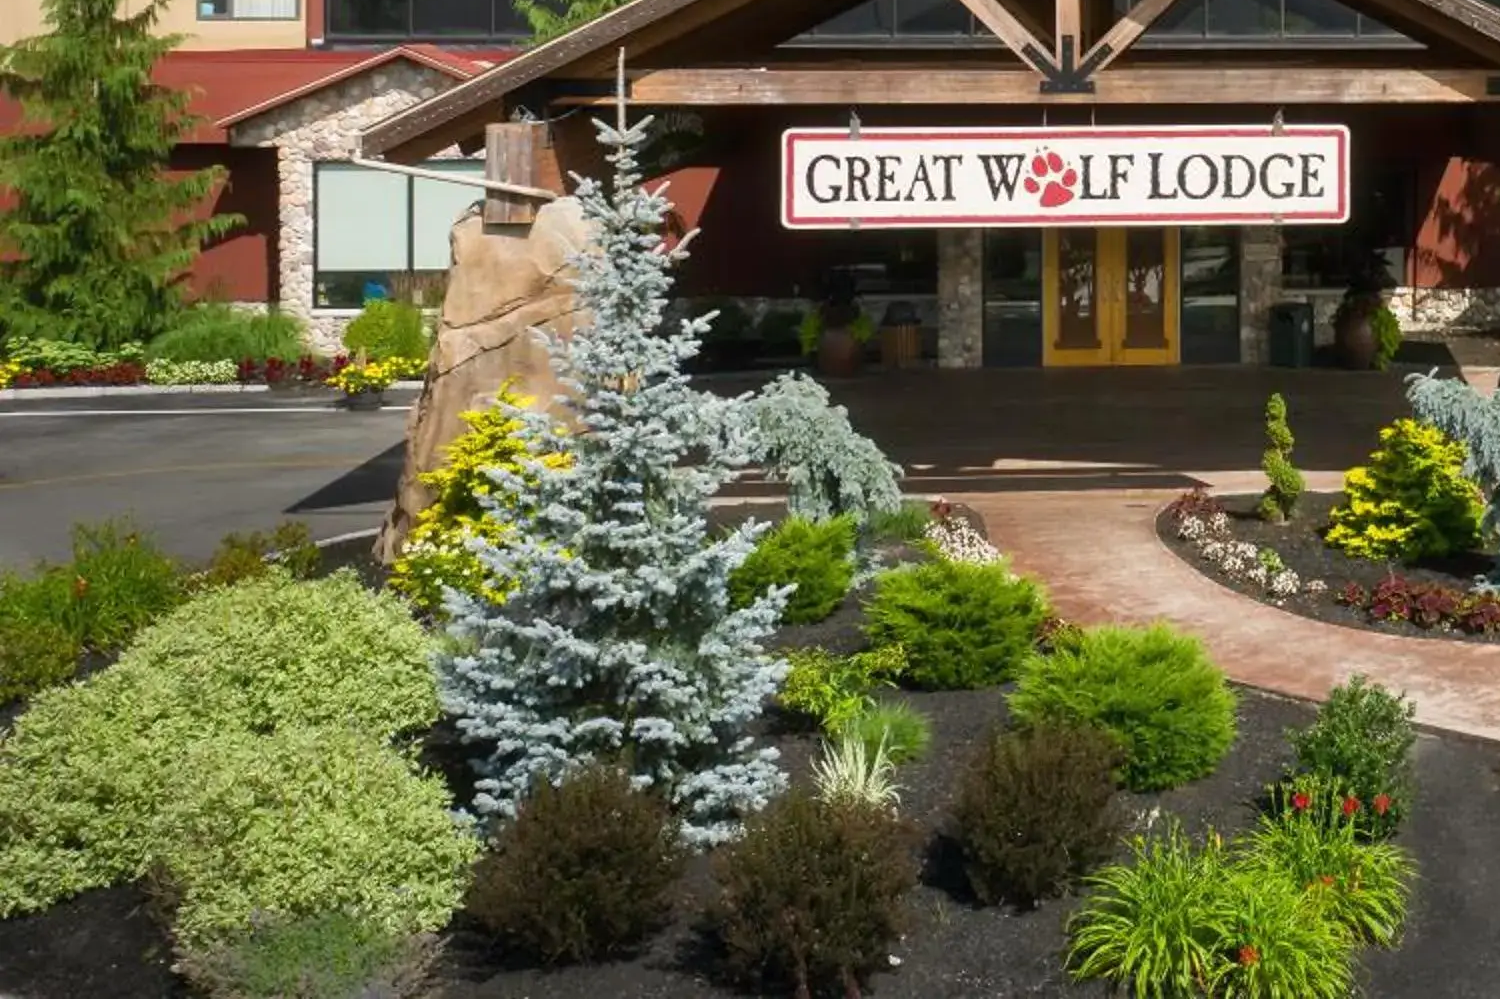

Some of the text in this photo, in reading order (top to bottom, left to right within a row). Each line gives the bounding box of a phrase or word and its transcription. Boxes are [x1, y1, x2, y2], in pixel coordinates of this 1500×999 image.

[805, 148, 1326, 208] GREAT WLF LODGE
